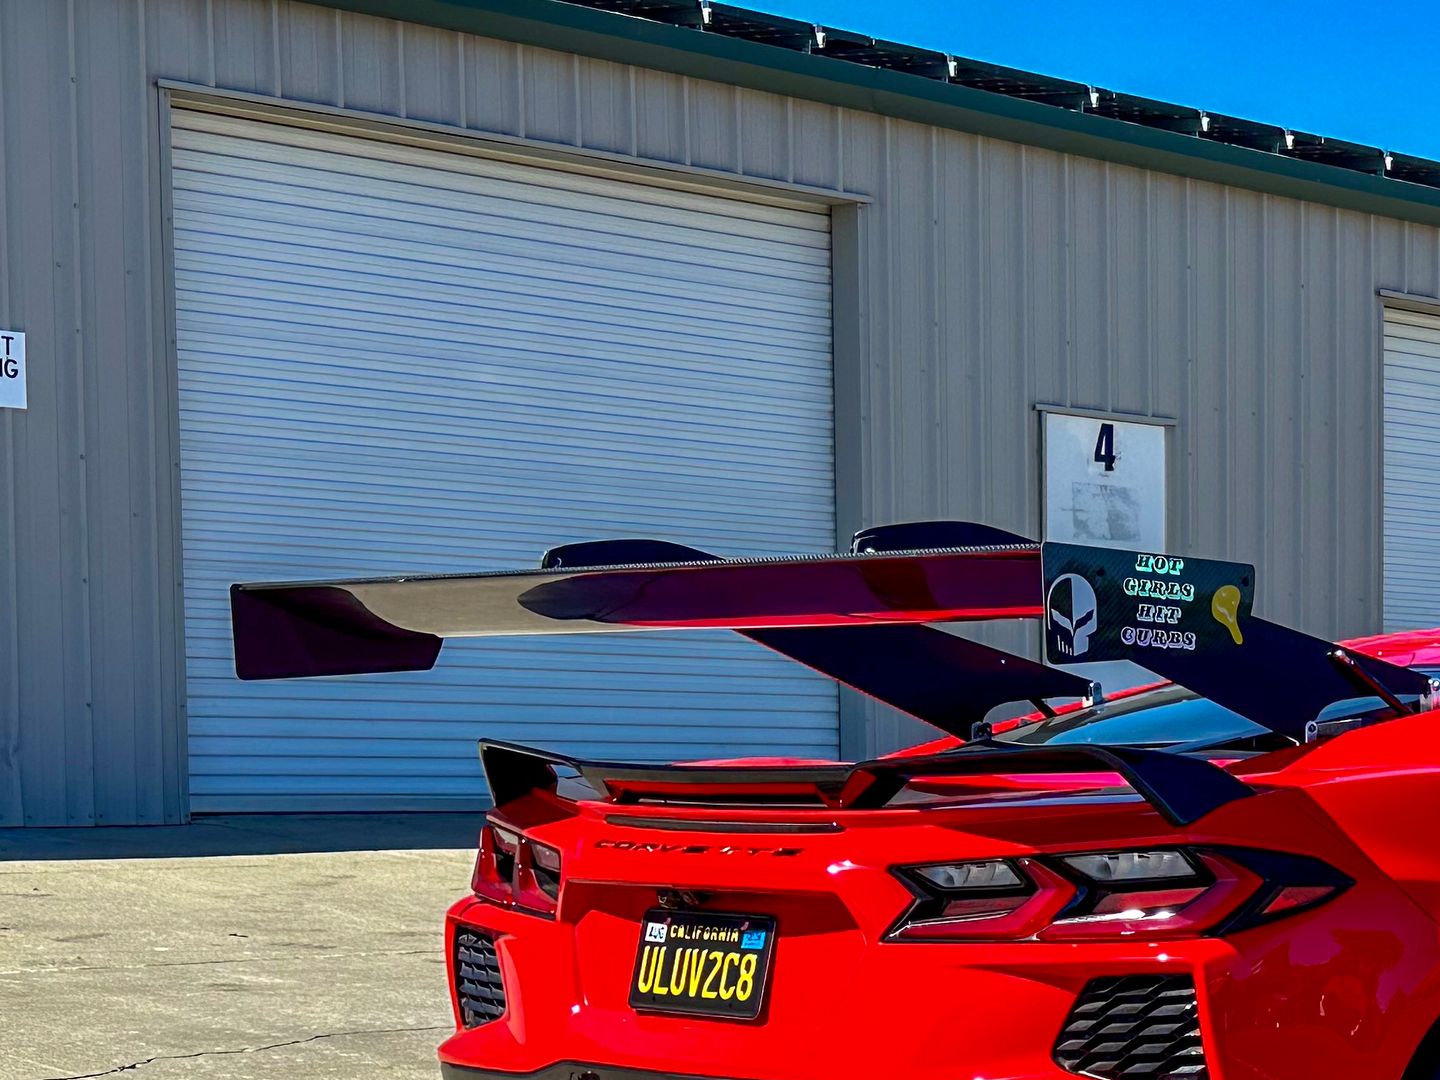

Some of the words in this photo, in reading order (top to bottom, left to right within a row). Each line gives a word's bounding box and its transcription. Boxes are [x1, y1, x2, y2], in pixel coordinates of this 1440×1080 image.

[0, 358, 18, 378] G
[1094, 423, 1116, 471] 4
[1135, 554, 1184, 575] HOT
[1123, 577, 1195, 601] GIRLS
[1137, 604, 1181, 624] HIT
[1121, 626, 1196, 650] CURBS
[670, 924, 739, 943] CALIFORNIA
[637, 945, 758, 1001] ULUV2C8
